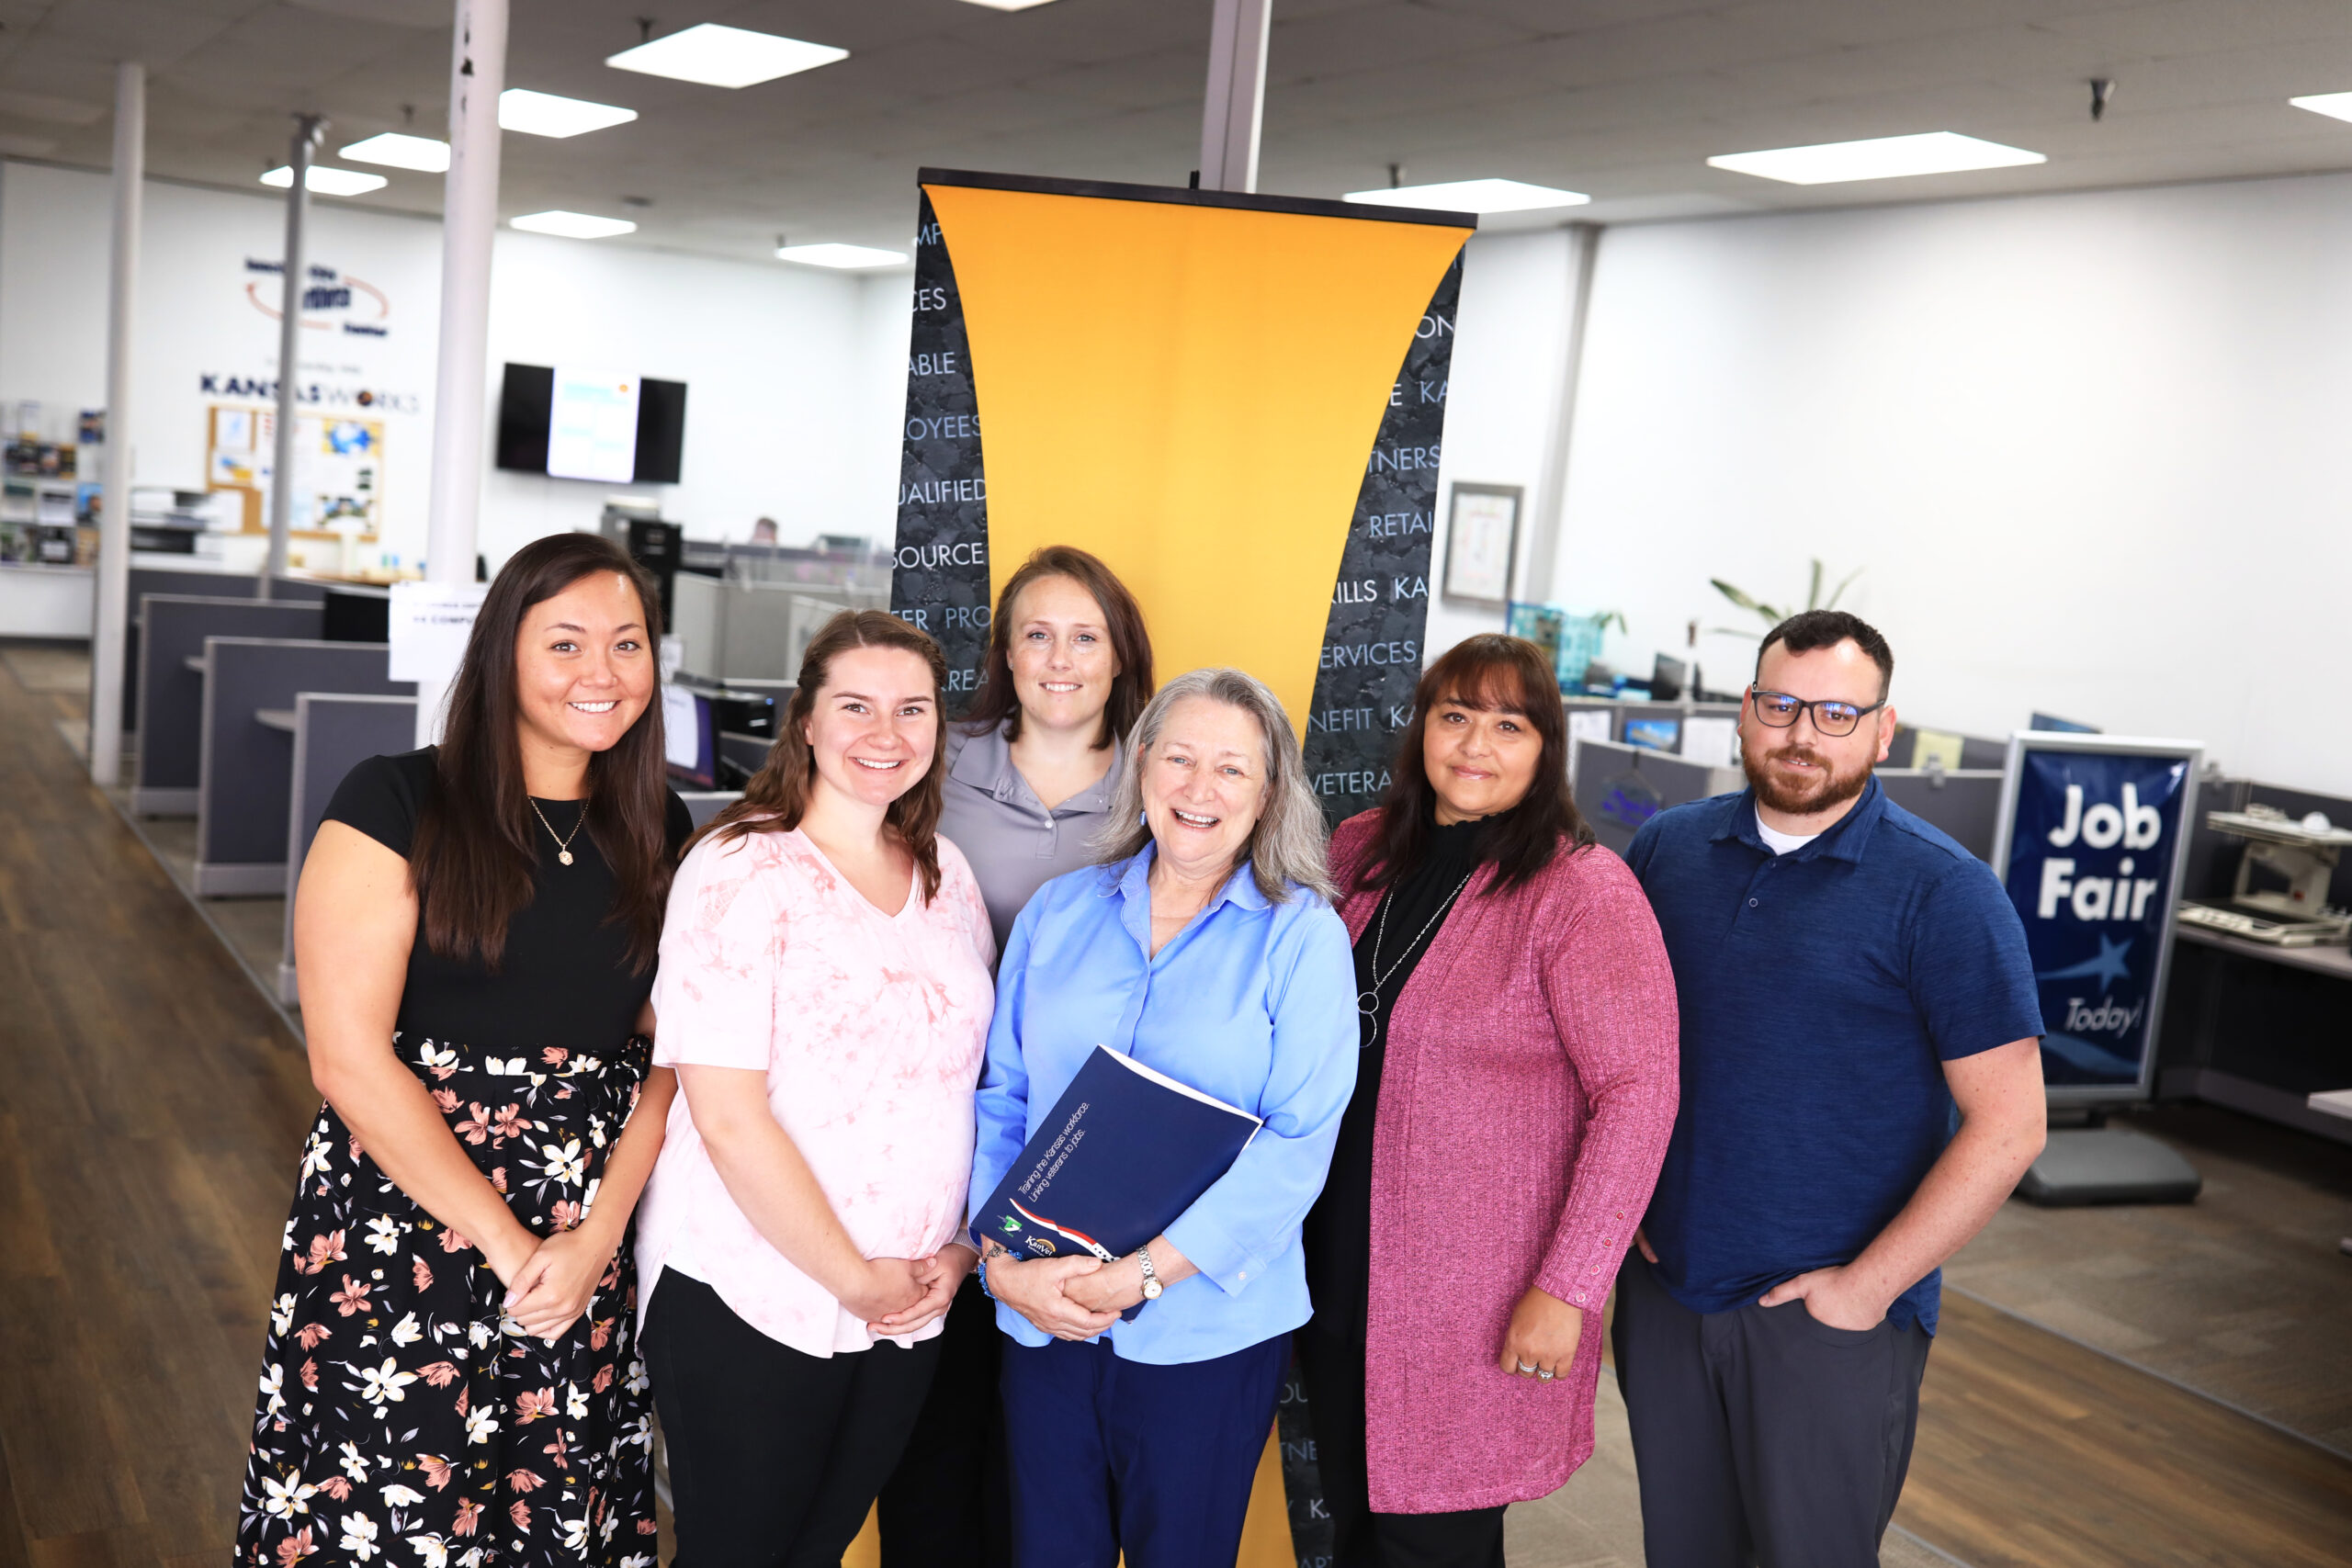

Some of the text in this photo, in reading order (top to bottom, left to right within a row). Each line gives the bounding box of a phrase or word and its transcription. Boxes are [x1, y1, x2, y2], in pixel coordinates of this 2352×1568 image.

[902, 415, 980, 441] OYEES
[1331, 576, 1429, 604] ILLS KA
[1320, 641, 1417, 669] ERVICES
[941, 669, 989, 693] REA
[2048, 783, 2162, 851] Job
[2038, 857, 2158, 921] Fair
[2066, 996, 2145, 1039] Today!
[1017, 1101, 1091, 1195] Training the Kansas workforce.
[1028, 1128, 1087, 1203] Linking veterans to jobs.
[1024, 1235, 1054, 1257] KanVet
